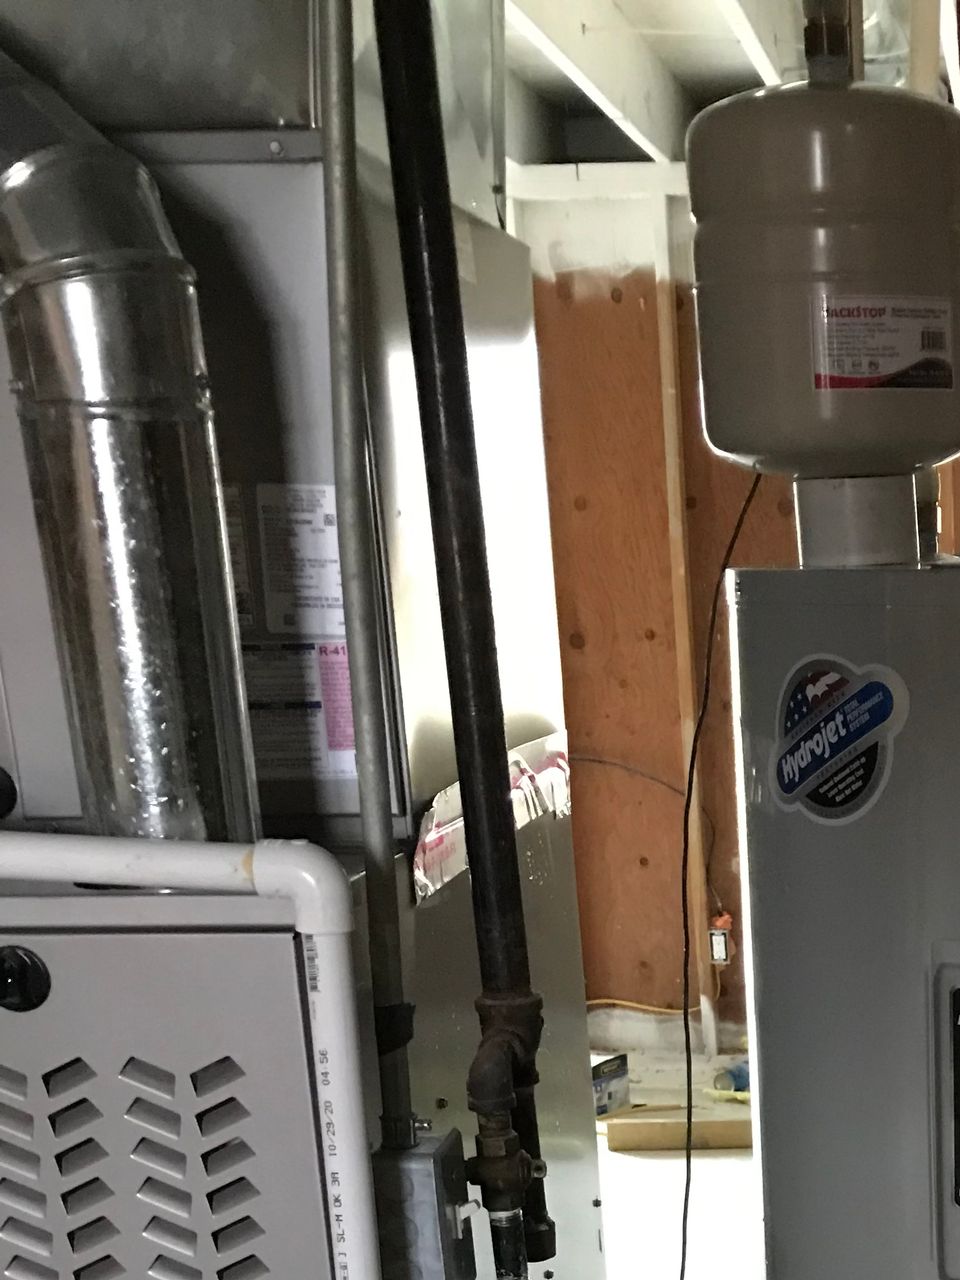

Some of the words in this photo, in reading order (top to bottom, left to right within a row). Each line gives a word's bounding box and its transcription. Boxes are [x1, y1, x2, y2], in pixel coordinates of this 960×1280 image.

[822, 305, 887, 319] ACKSTOP
[781, 710, 847, 785] Hydrojet
[324, 1100, 337, 1157] 10/29/20
[333, 1194, 342, 1208] OK
[335, 1214, 345, 1243] SL-M
